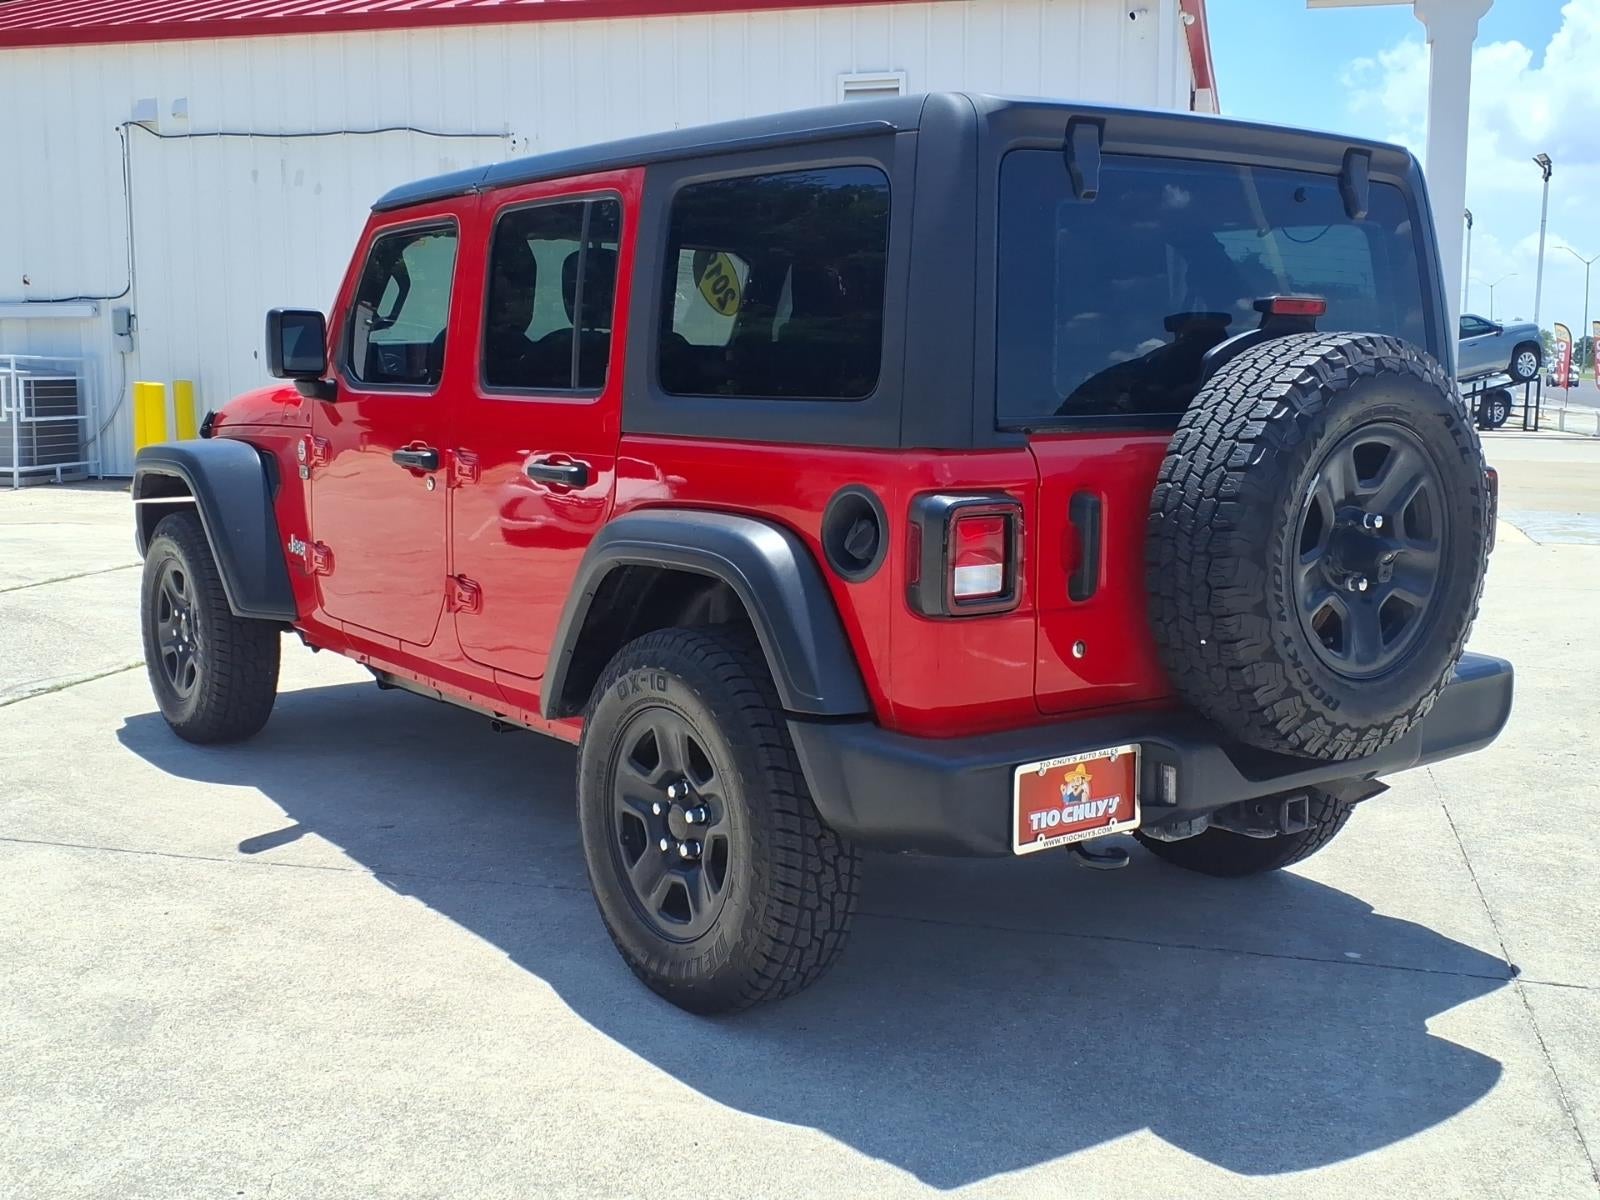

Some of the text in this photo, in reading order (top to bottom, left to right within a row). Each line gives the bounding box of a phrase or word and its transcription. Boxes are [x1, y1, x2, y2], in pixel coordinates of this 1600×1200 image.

[287, 533, 306, 561] Jeep
[1280, 632, 1340, 711] ROCKY
[1039, 748, 1119, 770] TIO CHUY'S AUTO SALES
[1030, 809, 1061, 831] TIO
[1042, 827, 1113, 847] WWW.TIOCHUYS.COM
